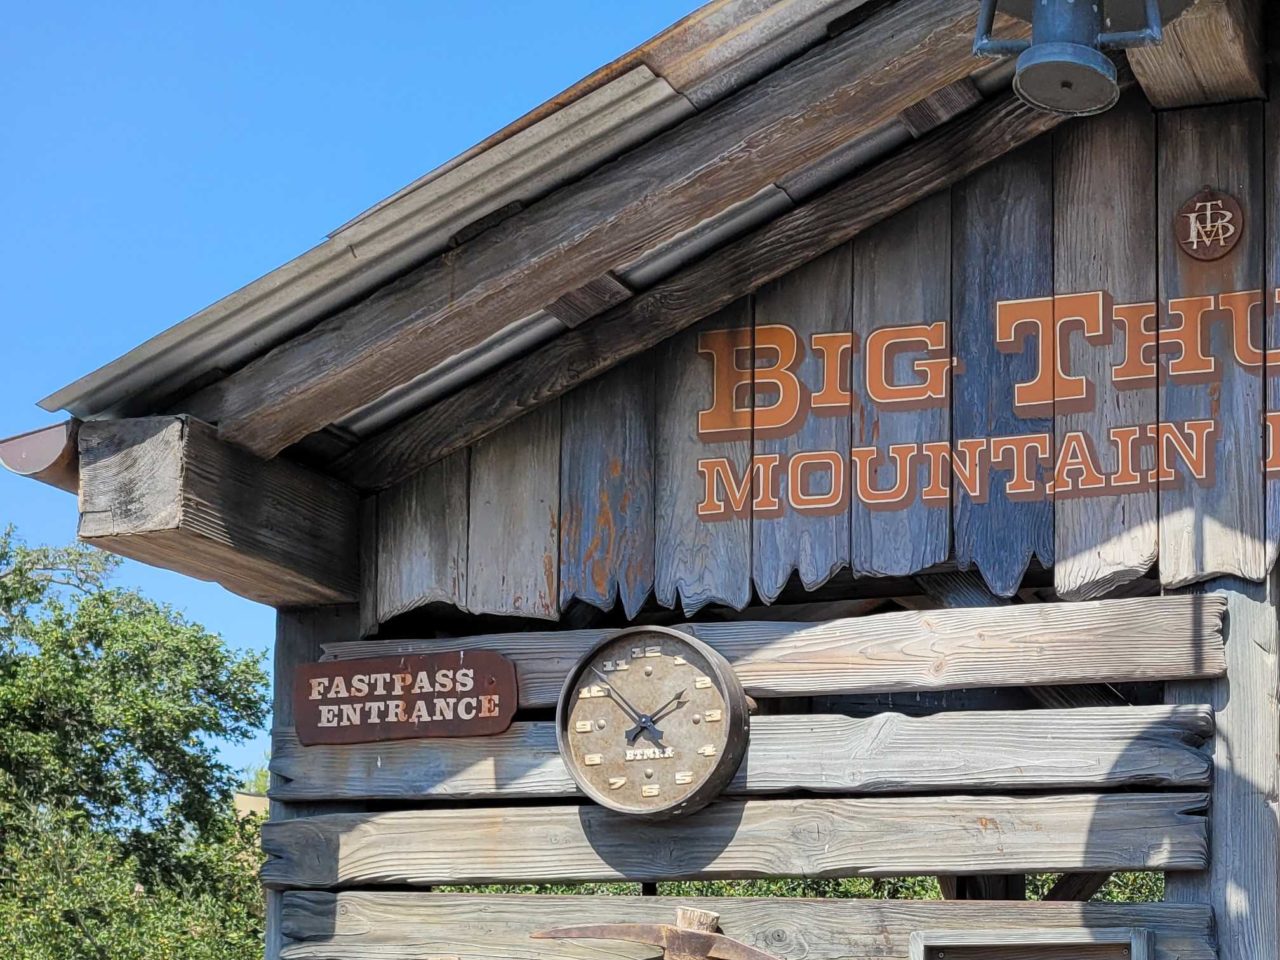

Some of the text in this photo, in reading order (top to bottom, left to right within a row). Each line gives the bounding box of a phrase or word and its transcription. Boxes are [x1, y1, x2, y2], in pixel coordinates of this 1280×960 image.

[698, 322, 960, 438] BIG
[697, 419, 1218, 517] MOUNTAIN
[308, 668, 473, 700] FASTPASS
[318, 695, 499, 727] ENTRANCE
